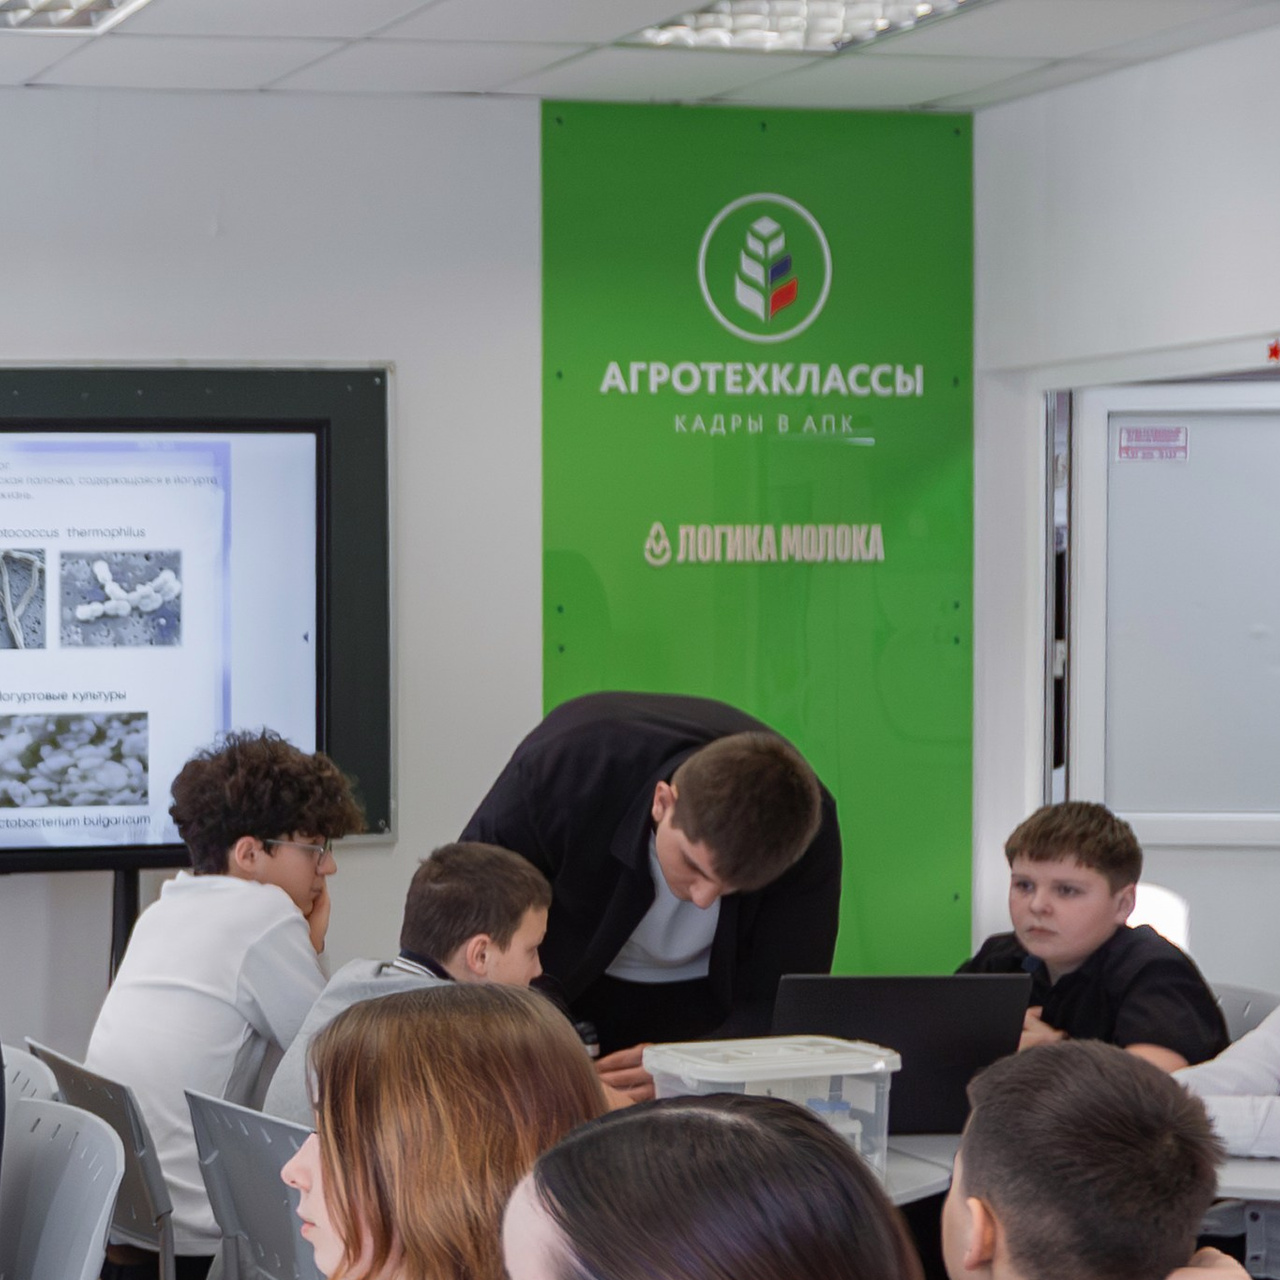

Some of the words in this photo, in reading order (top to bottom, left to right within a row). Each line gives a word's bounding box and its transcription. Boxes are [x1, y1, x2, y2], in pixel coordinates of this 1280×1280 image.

[600, 361, 924, 397] АГРОТЕХКЛАССЫ
[675, 413, 764, 436] КАДРЫ
[778, 413, 790, 433] В
[803, 414, 854, 434] АПК
[66, 526, 147, 540] thermophilus
[676, 523, 778, 563] ЛОГИКА
[781, 523, 886, 562] МОЛОКА
[72, 690, 127, 703] культуры
[83, 814, 151, 829] bulgaricum
